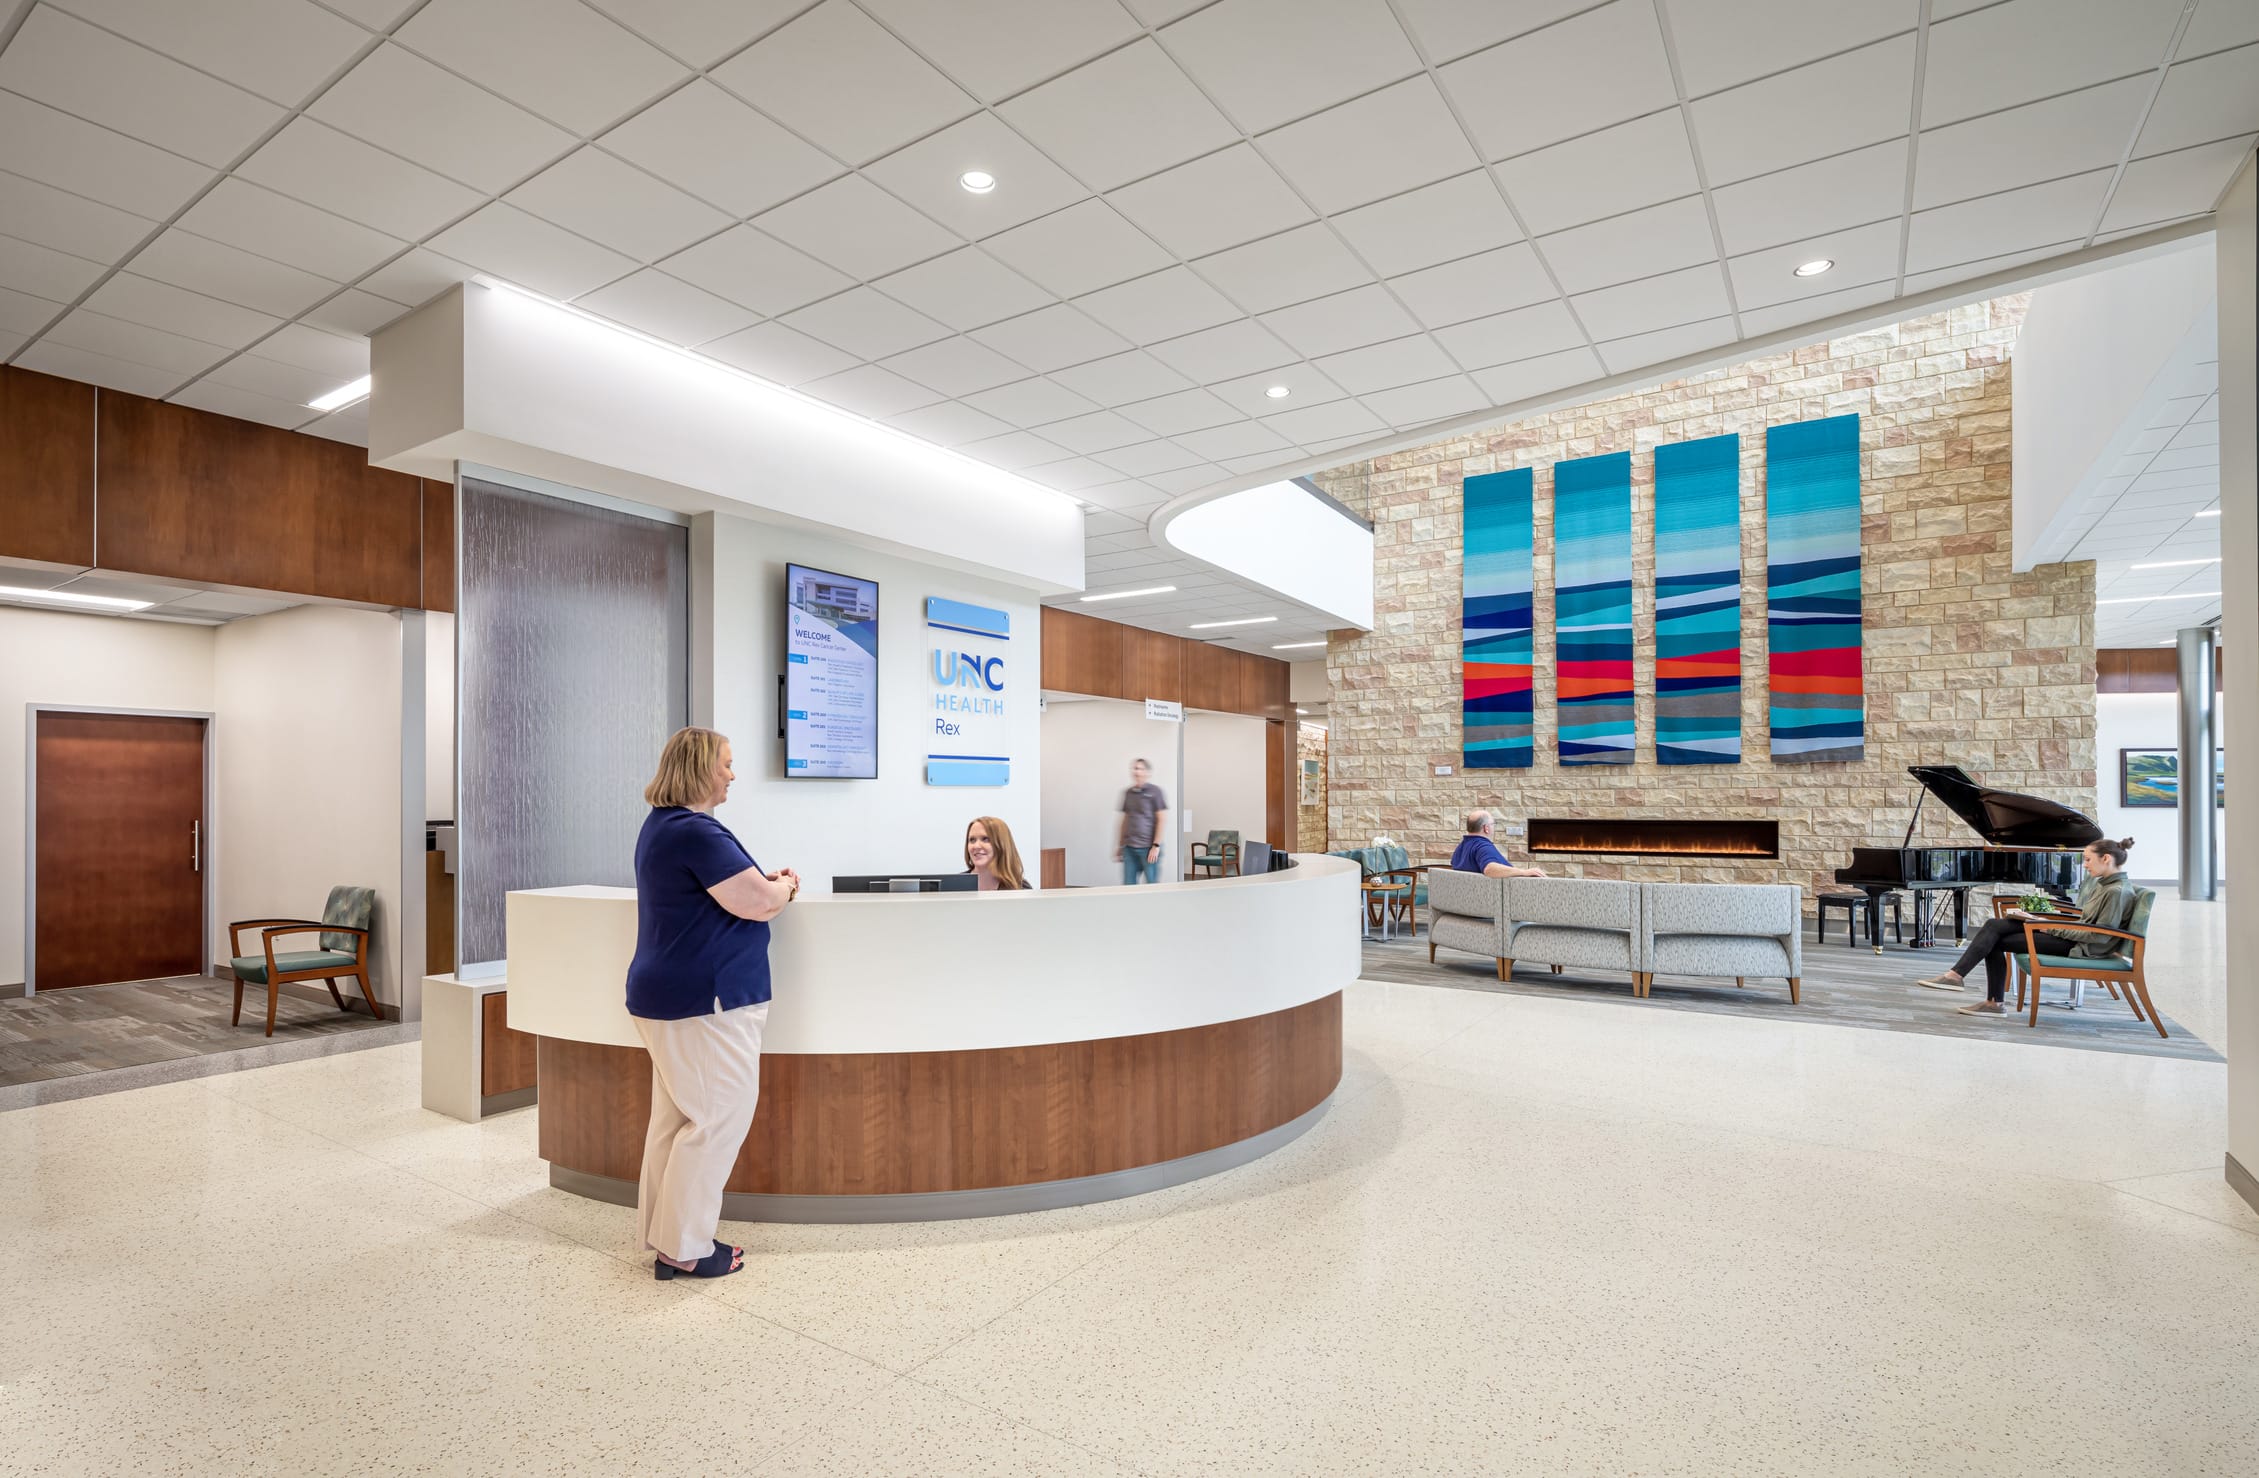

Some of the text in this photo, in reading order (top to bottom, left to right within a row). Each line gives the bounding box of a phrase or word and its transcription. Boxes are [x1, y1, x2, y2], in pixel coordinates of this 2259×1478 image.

[795, 629, 831, 642] WELCOME
[935, 649, 1004, 691] UNC
[936, 693, 1004, 715] HEALTH
[935, 718, 961, 735] Rex
